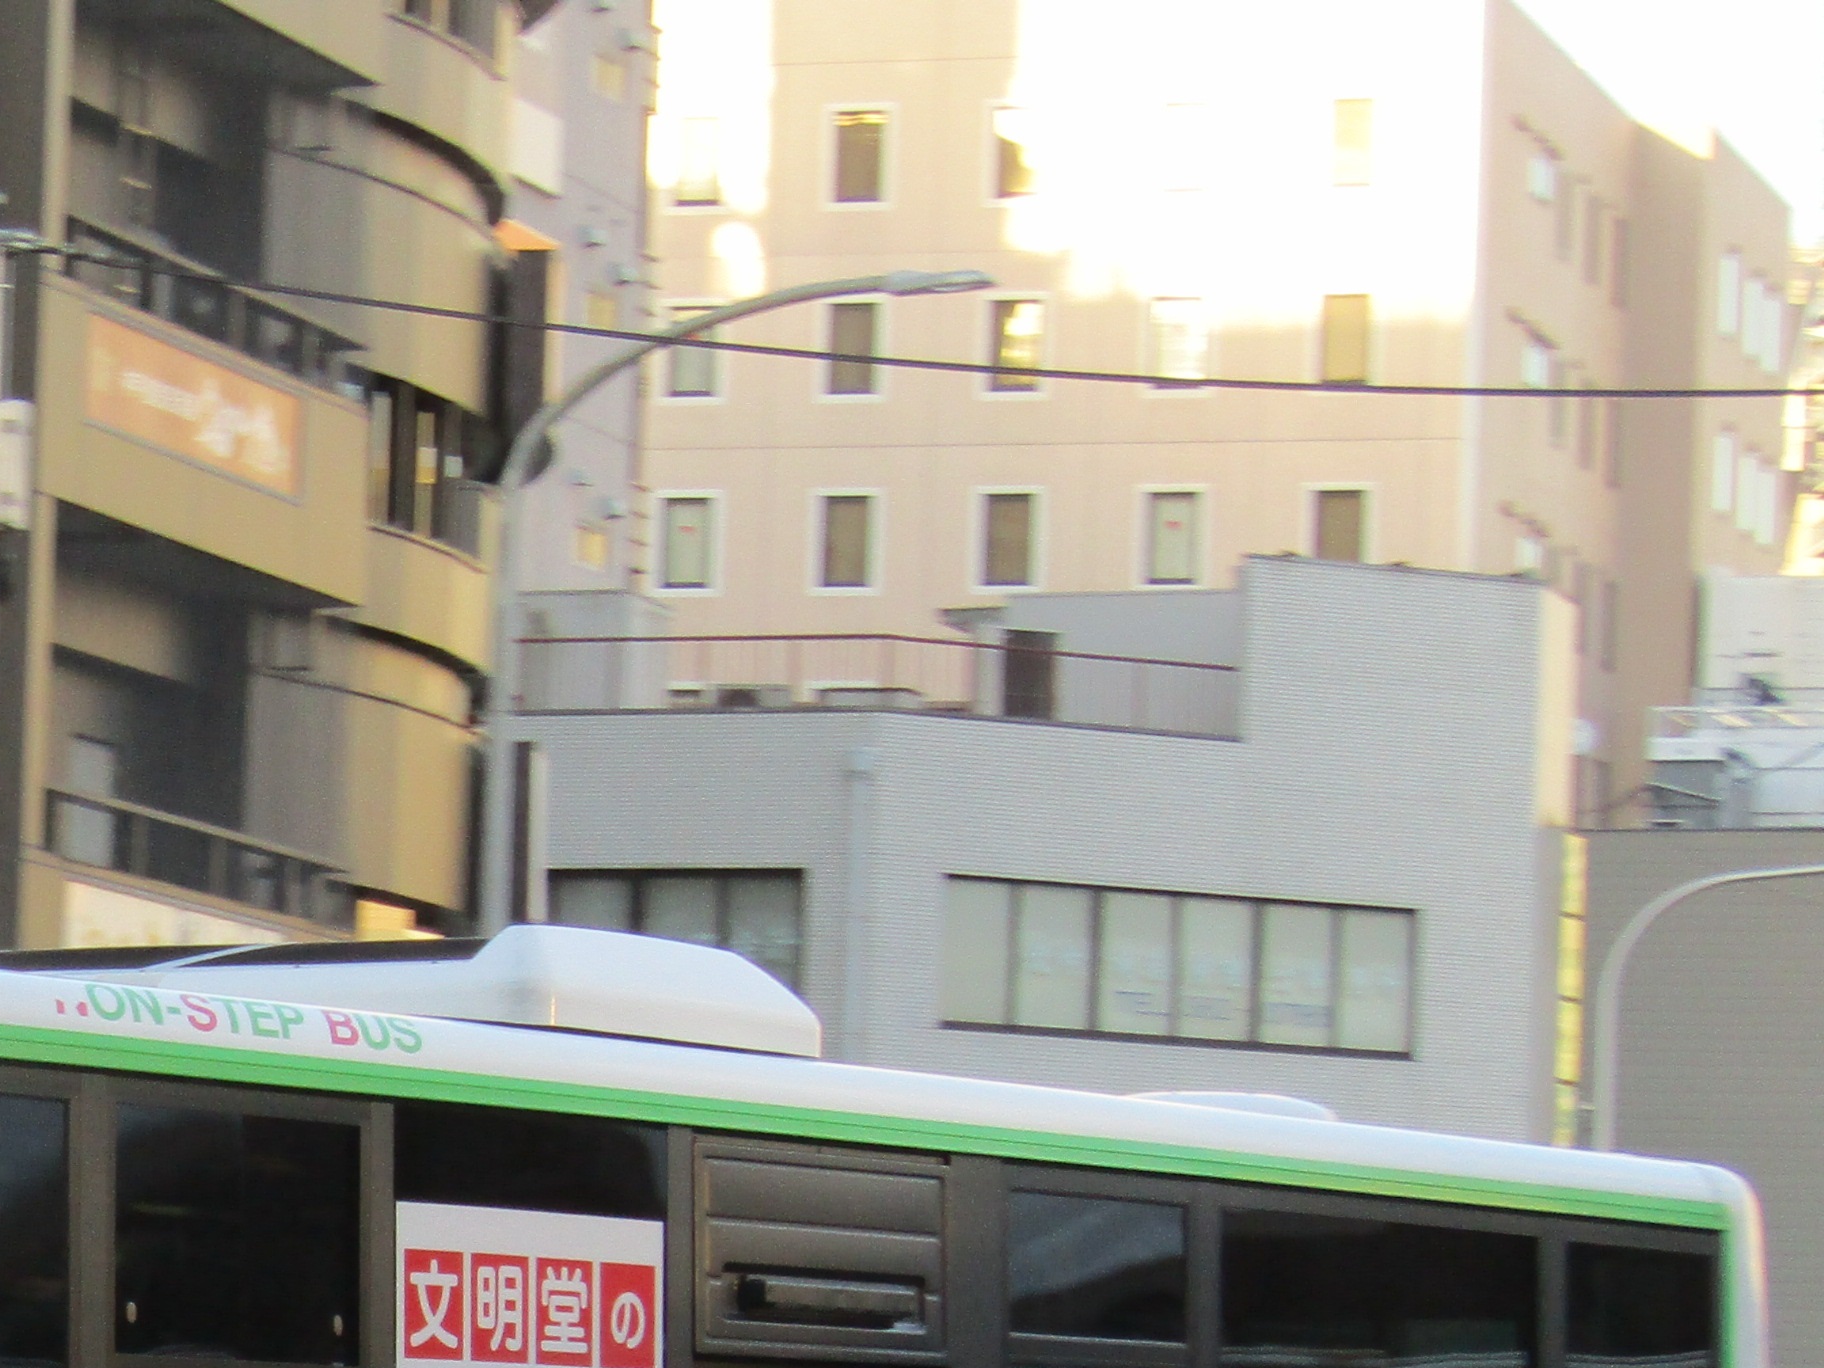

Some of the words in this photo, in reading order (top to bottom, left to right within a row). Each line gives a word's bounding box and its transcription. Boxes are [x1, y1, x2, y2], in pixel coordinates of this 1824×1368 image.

[324, 1006, 424, 1054] BUS
[408, 1258, 647, 1354] 文明堂の
